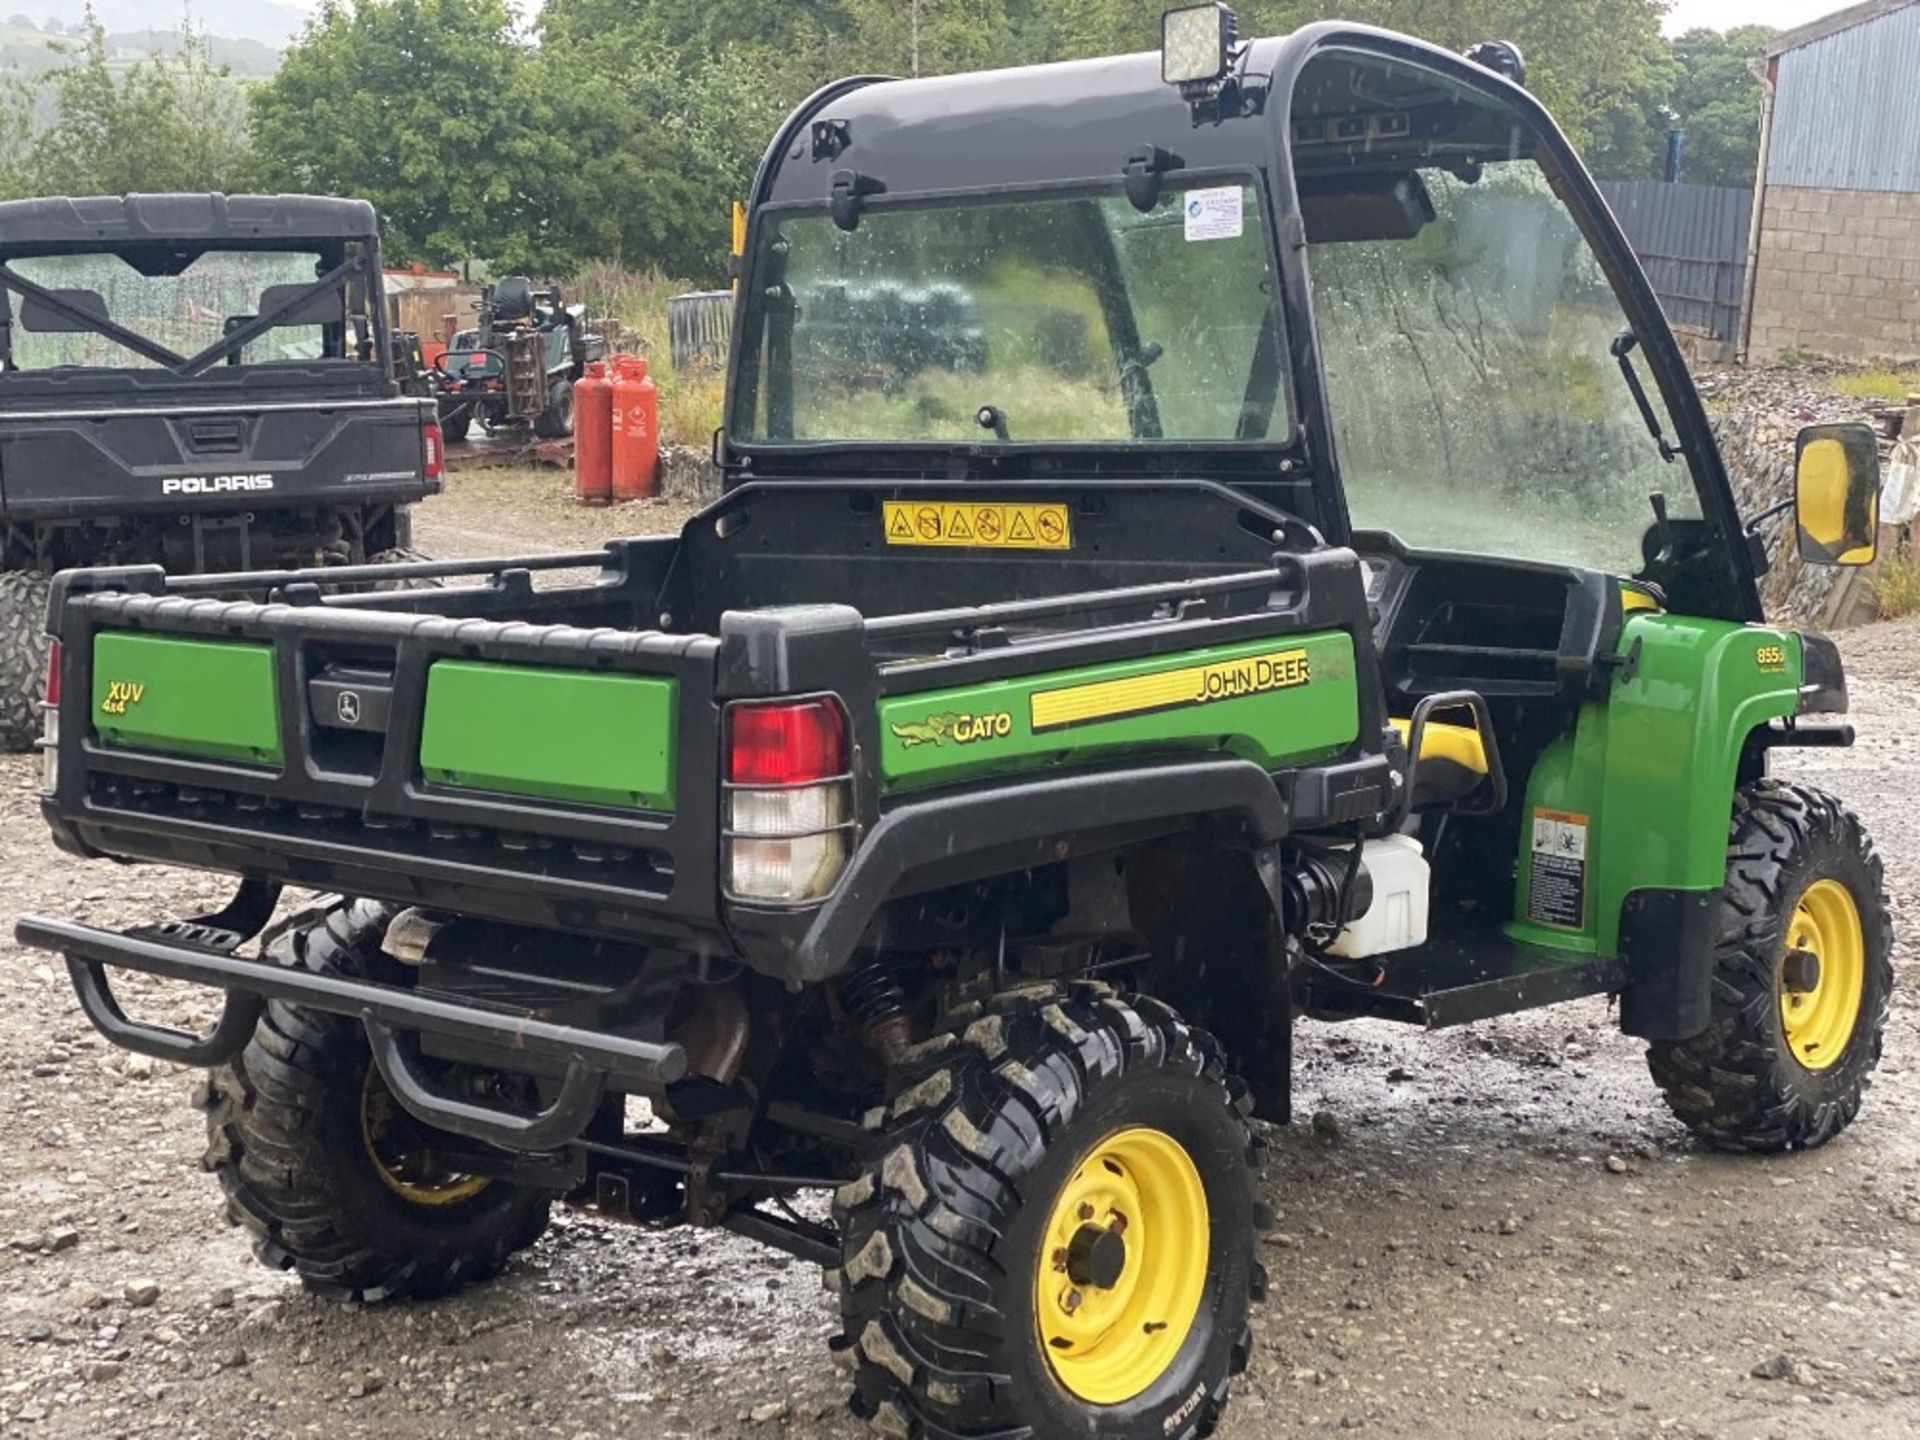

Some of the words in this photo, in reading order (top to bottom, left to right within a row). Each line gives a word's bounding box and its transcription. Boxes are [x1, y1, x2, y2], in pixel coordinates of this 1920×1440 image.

[162, 474, 273, 494] POLARIS
[108, 680, 145, 702] XUV
[1197, 666, 1251, 698] JOHN
[952, 712, 1013, 743] GATO
